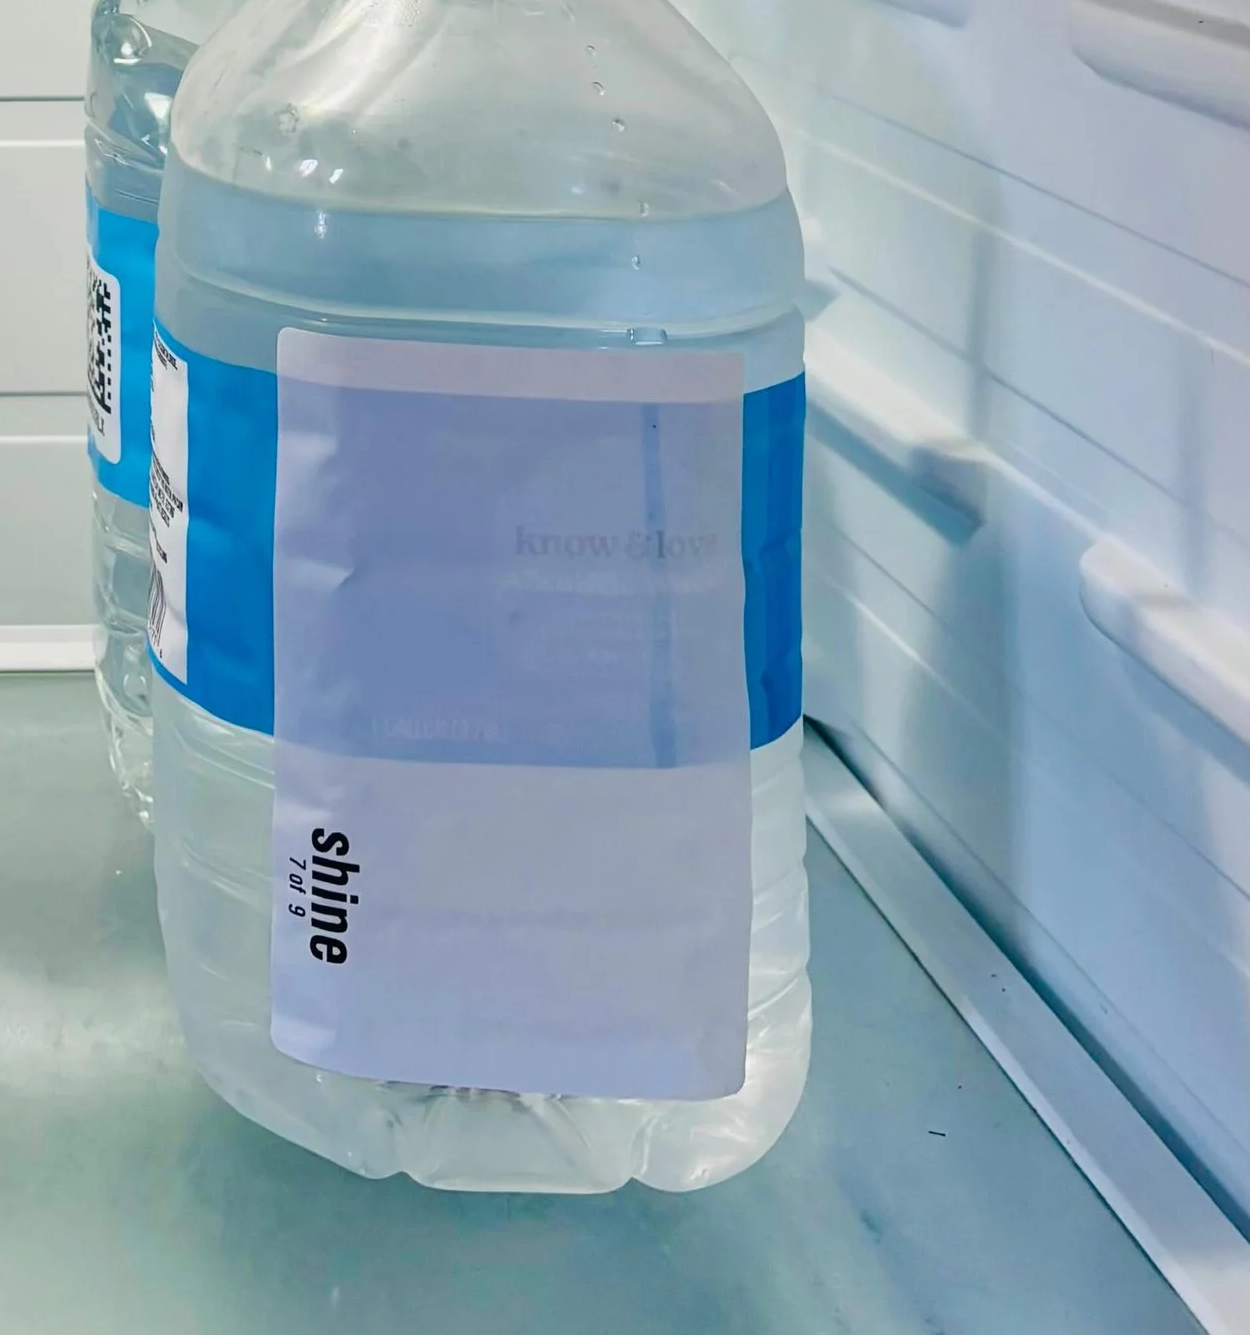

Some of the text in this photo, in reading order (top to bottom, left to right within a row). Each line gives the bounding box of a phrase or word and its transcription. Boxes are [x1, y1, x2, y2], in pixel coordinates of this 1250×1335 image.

[515, 524, 619, 558] know
[289, 857, 306, 918] 7 of 9
[310, 828, 360, 964] shine
